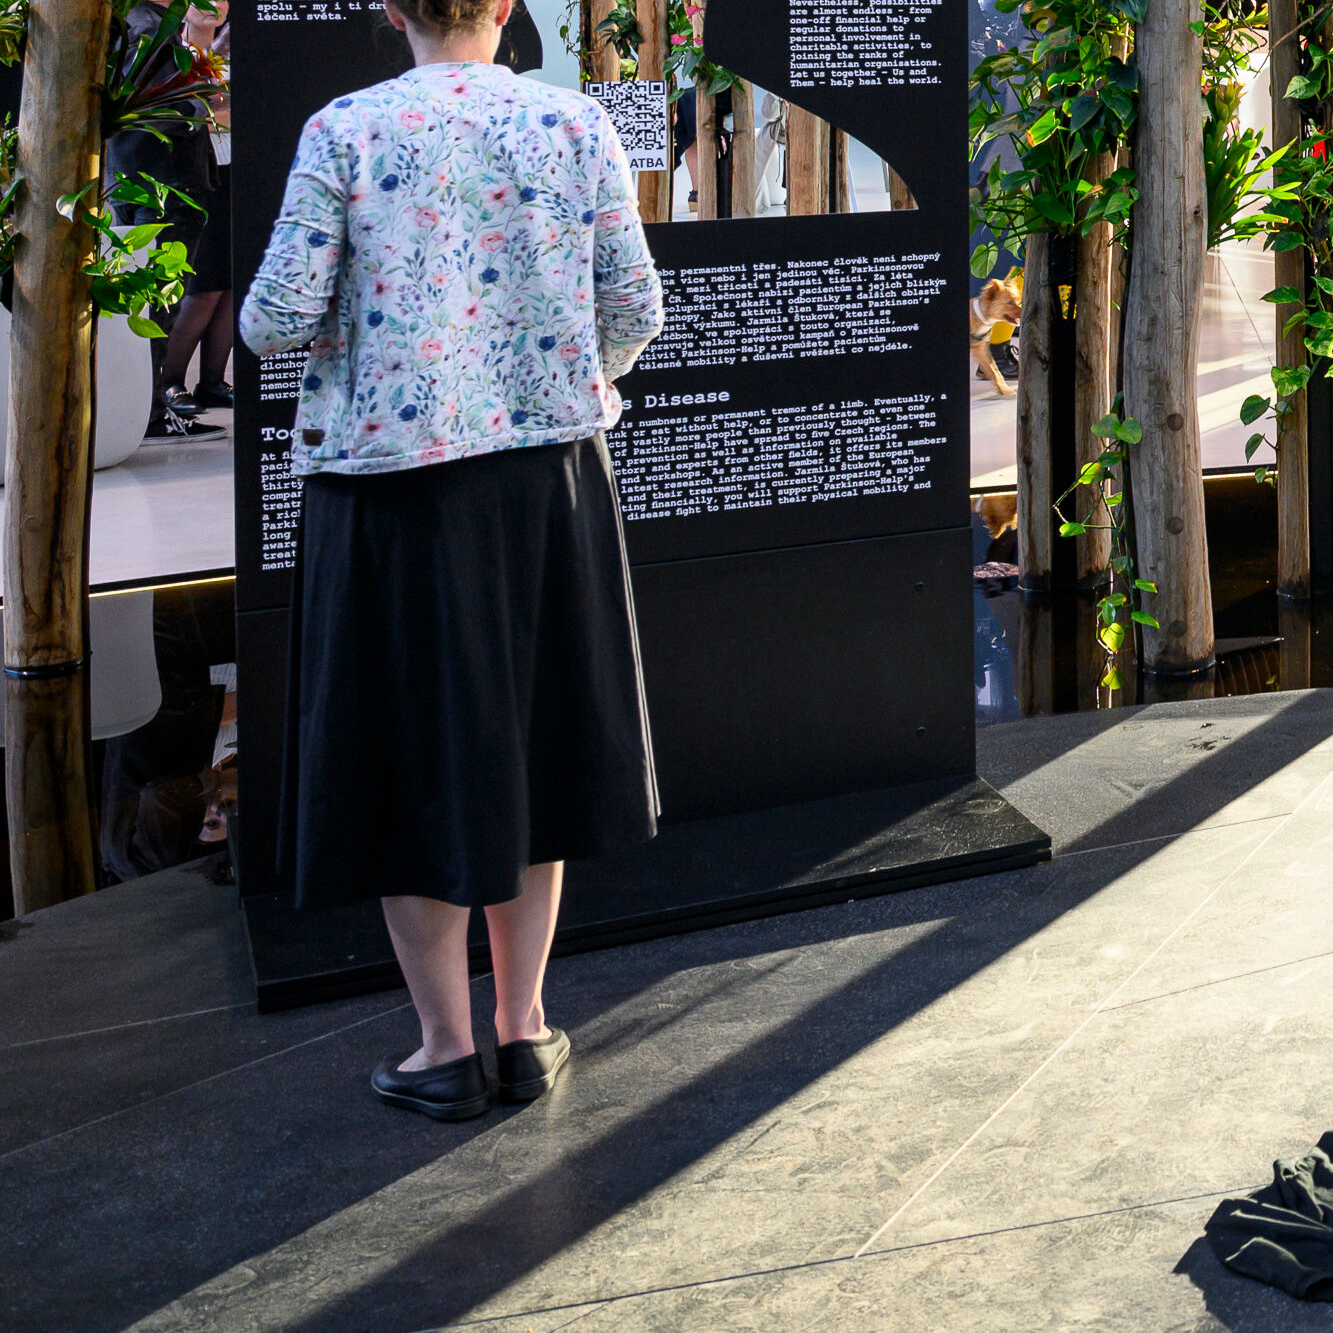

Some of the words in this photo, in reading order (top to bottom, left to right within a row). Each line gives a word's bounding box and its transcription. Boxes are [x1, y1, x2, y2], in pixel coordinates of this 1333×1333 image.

[629, 157, 665, 169] ATBA
[868, 280, 902, 292] jejich
[746, 314, 788, 325] Jarmila
[644, 390, 730, 409] Disease
[633, 438, 719, 457] Parkinson-Help
[723, 436, 748, 446] have
[753, 432, 789, 445] spread
[811, 428, 829, 438] five
[834, 425, 864, 436] Czech
[868, 421, 912, 434] regions.
[918, 418, 936, 428] The
[650, 494, 717, 510] financially,
[724, 493, 743, 503] you
[747, 488, 772, 498] will
[777, 484, 818, 497] support
[823, 473, 914, 492] Parkinson-Help's
